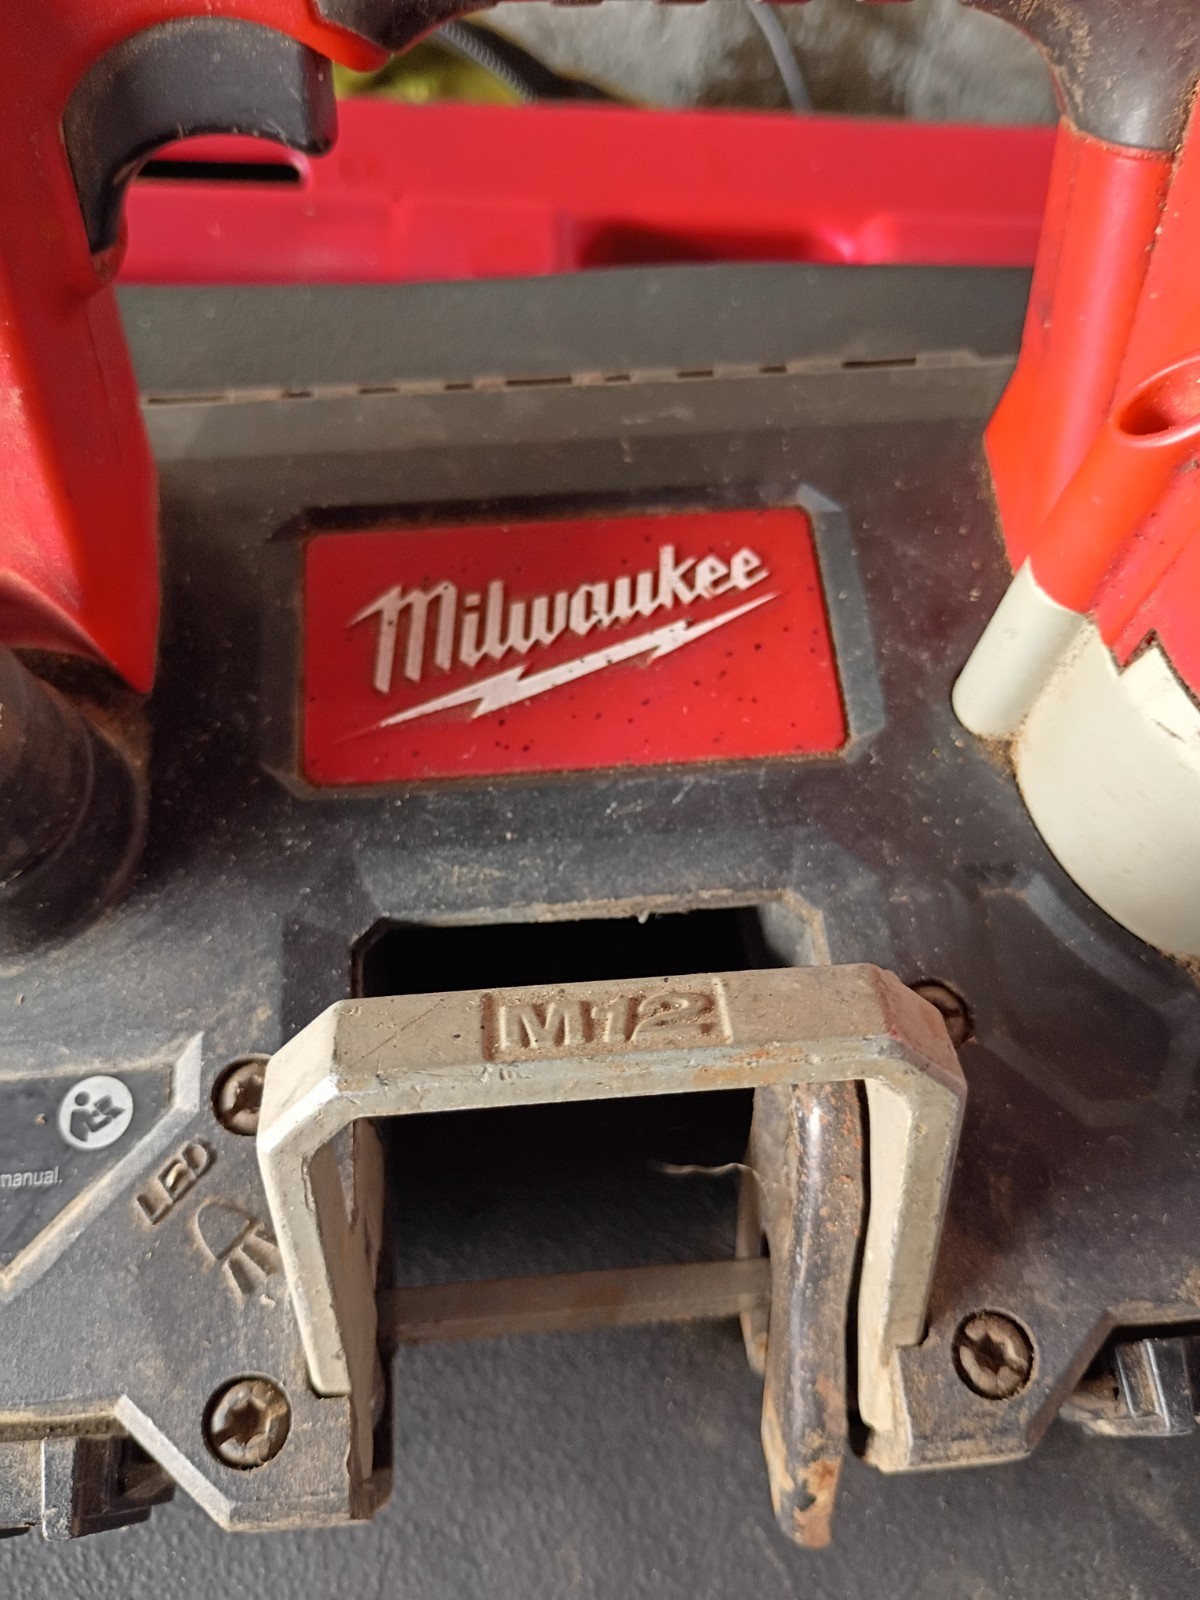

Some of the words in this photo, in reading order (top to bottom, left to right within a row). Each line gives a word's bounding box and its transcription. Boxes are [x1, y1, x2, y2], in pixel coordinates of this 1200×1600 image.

[346, 543, 770, 694] Milwaukee
[498, 991, 714, 1050] M12
[136, 1138, 217, 1225] LED
